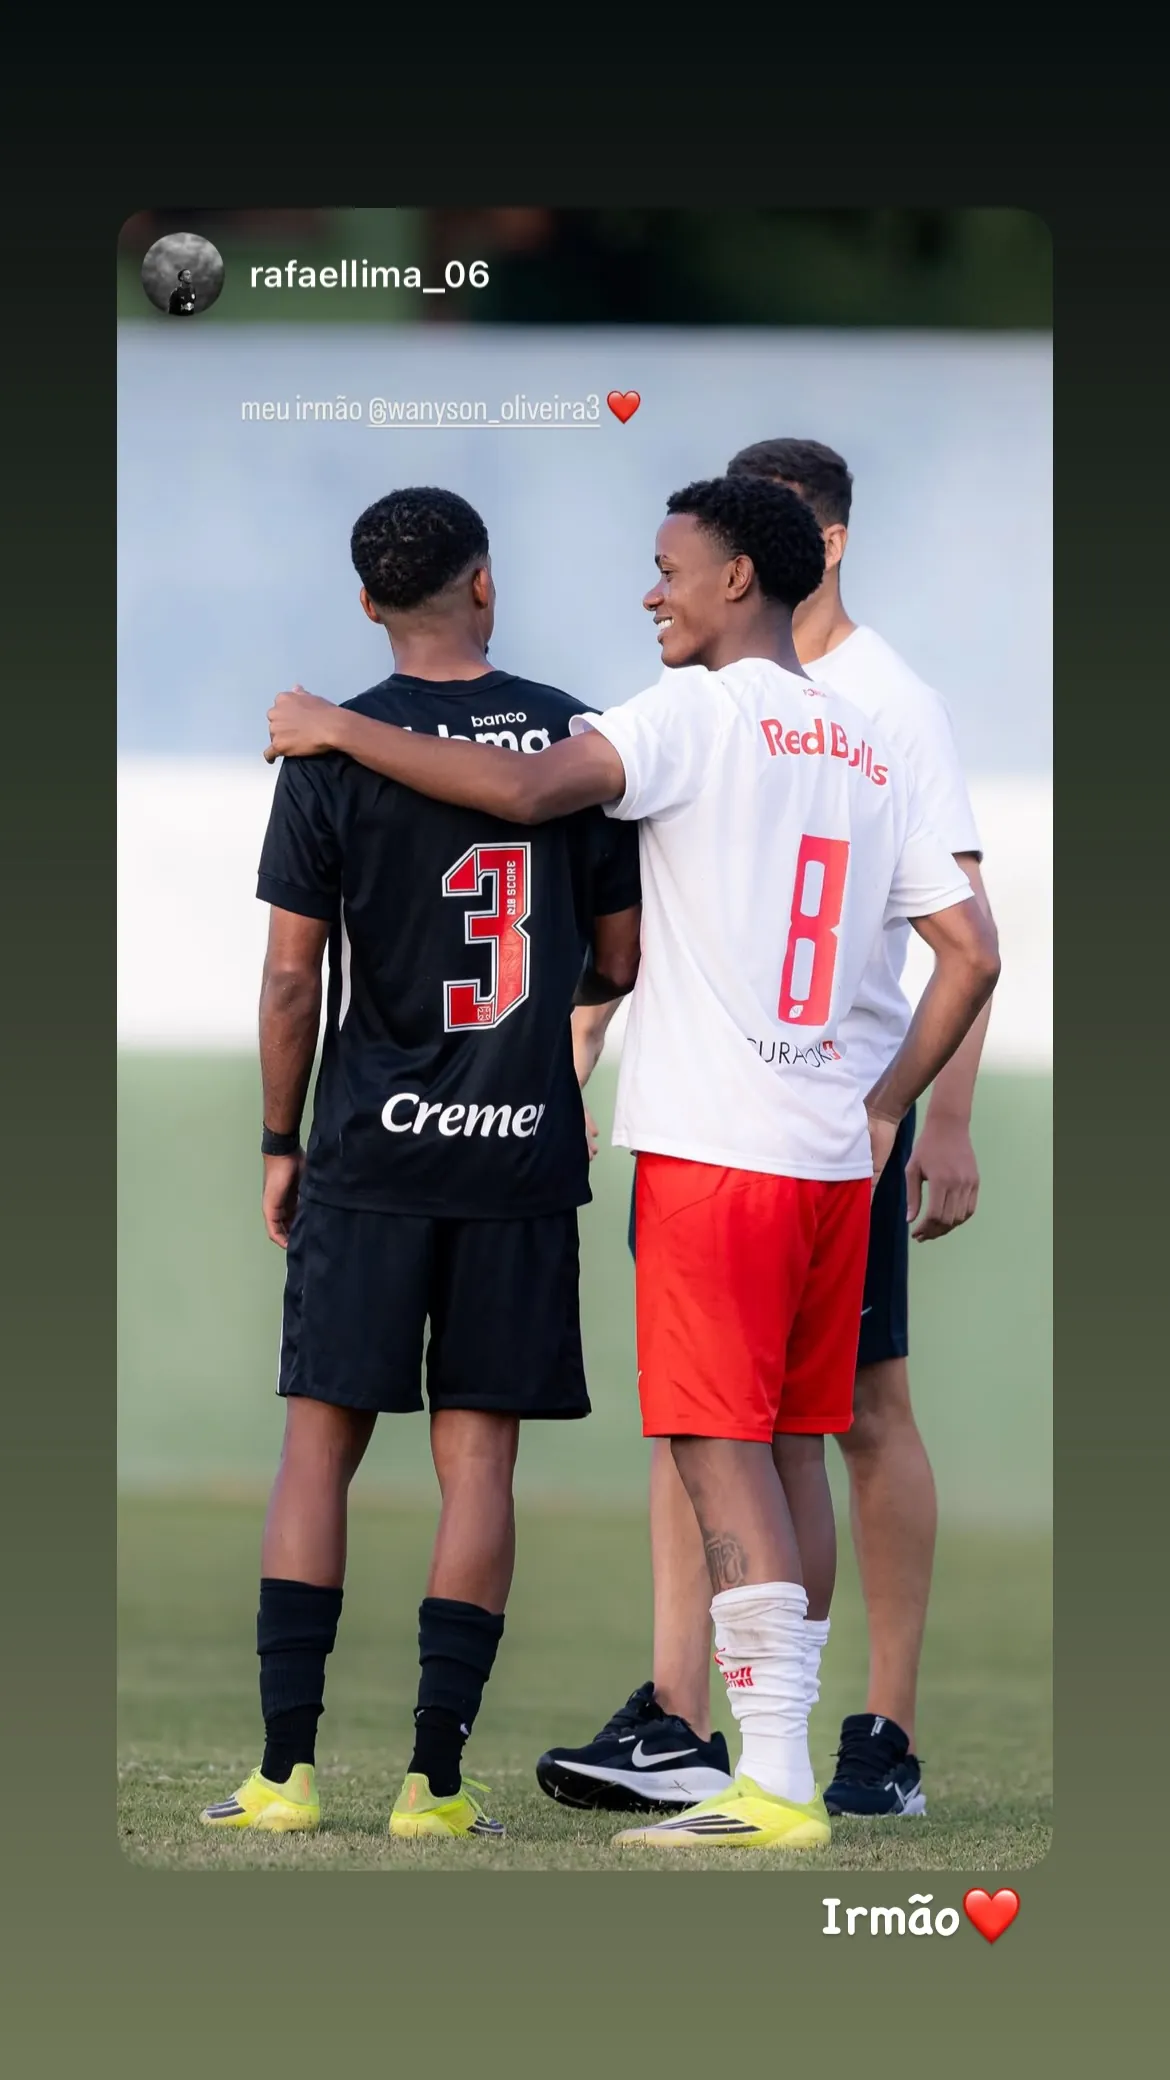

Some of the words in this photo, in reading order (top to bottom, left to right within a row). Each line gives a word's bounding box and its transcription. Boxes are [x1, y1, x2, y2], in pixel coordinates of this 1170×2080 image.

[471, 711, 527, 728] banco
[760, 718, 825, 756] Red
[506, 860, 516, 896] SCORE
[442, 841, 532, 1034] 3
[778, 833, 850, 1026] 8
